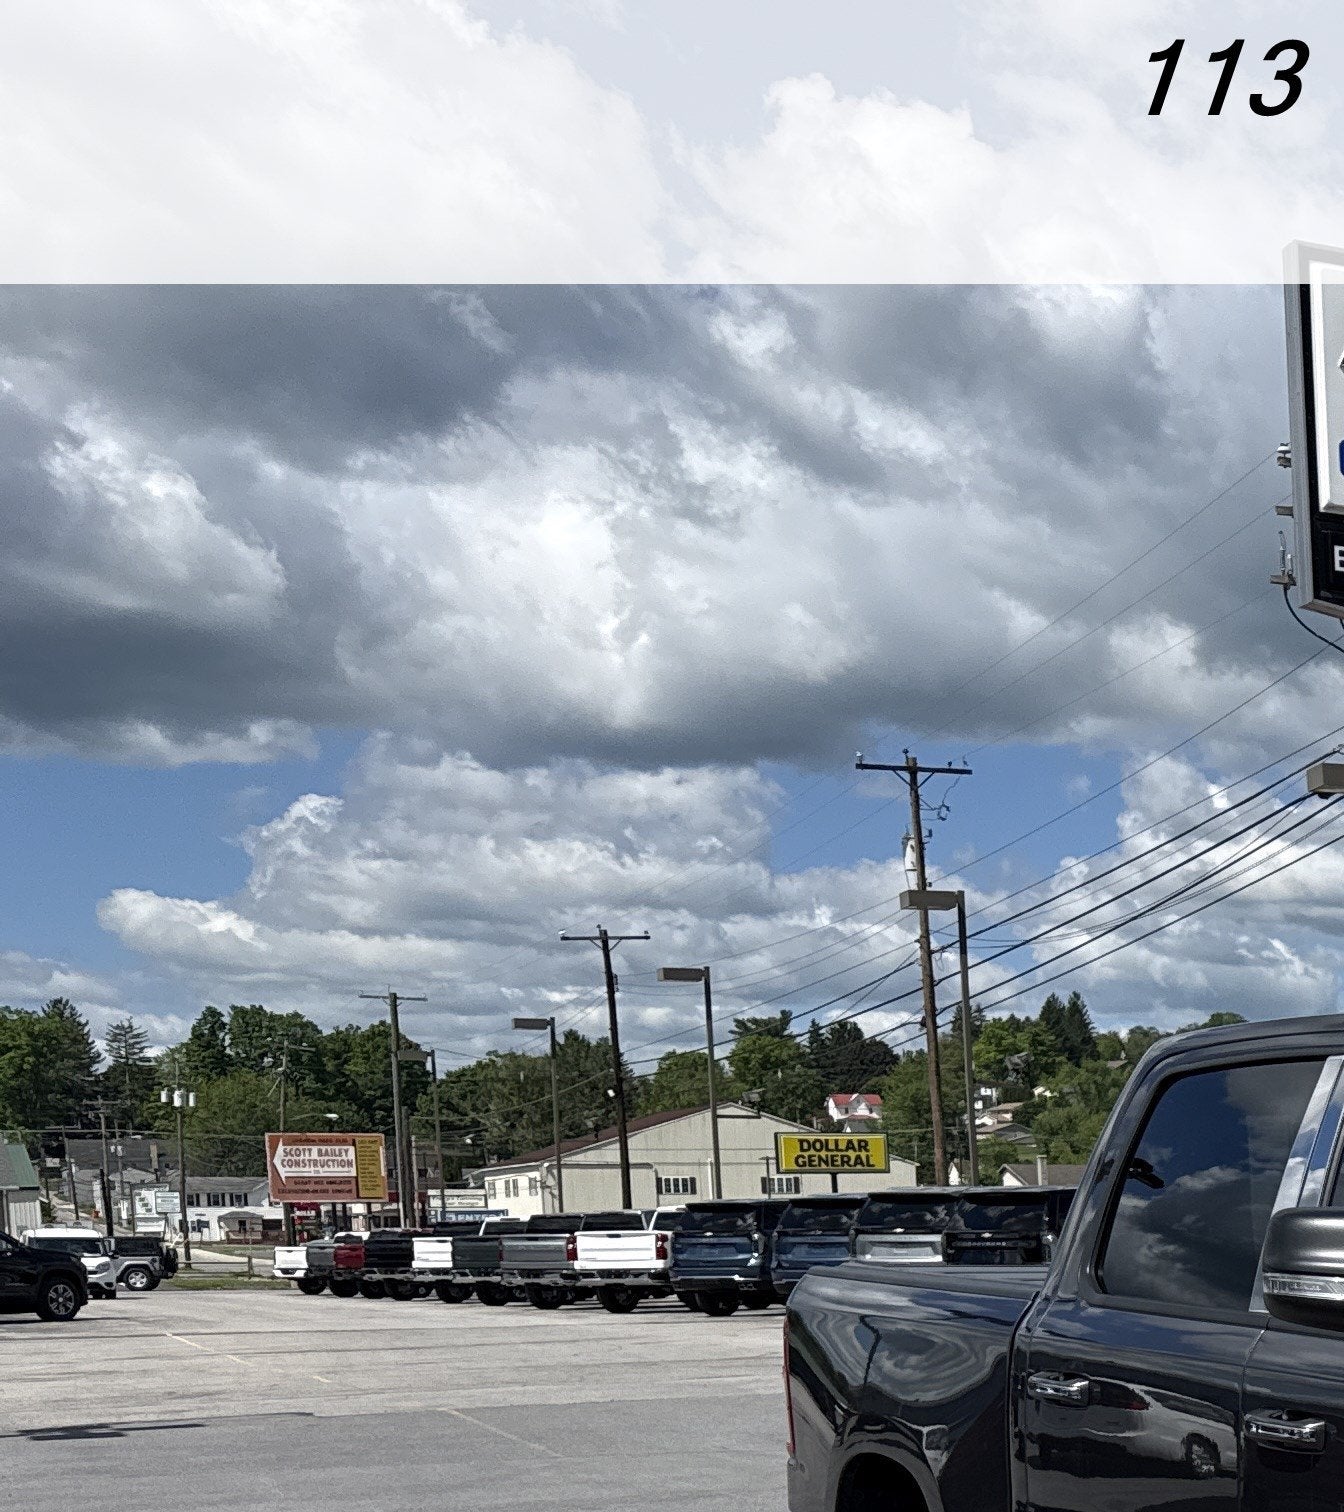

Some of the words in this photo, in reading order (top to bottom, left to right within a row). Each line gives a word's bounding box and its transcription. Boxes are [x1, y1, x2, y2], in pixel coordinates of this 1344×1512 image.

[797, 1138, 870, 1153] DOLLAR
[282, 1147, 313, 1158] SCOTT
[316, 1147, 350, 1158] BAILEY
[280, 1158, 354, 1169] CONSTRUCTION
[794, 1153, 876, 1168] GENERAL
